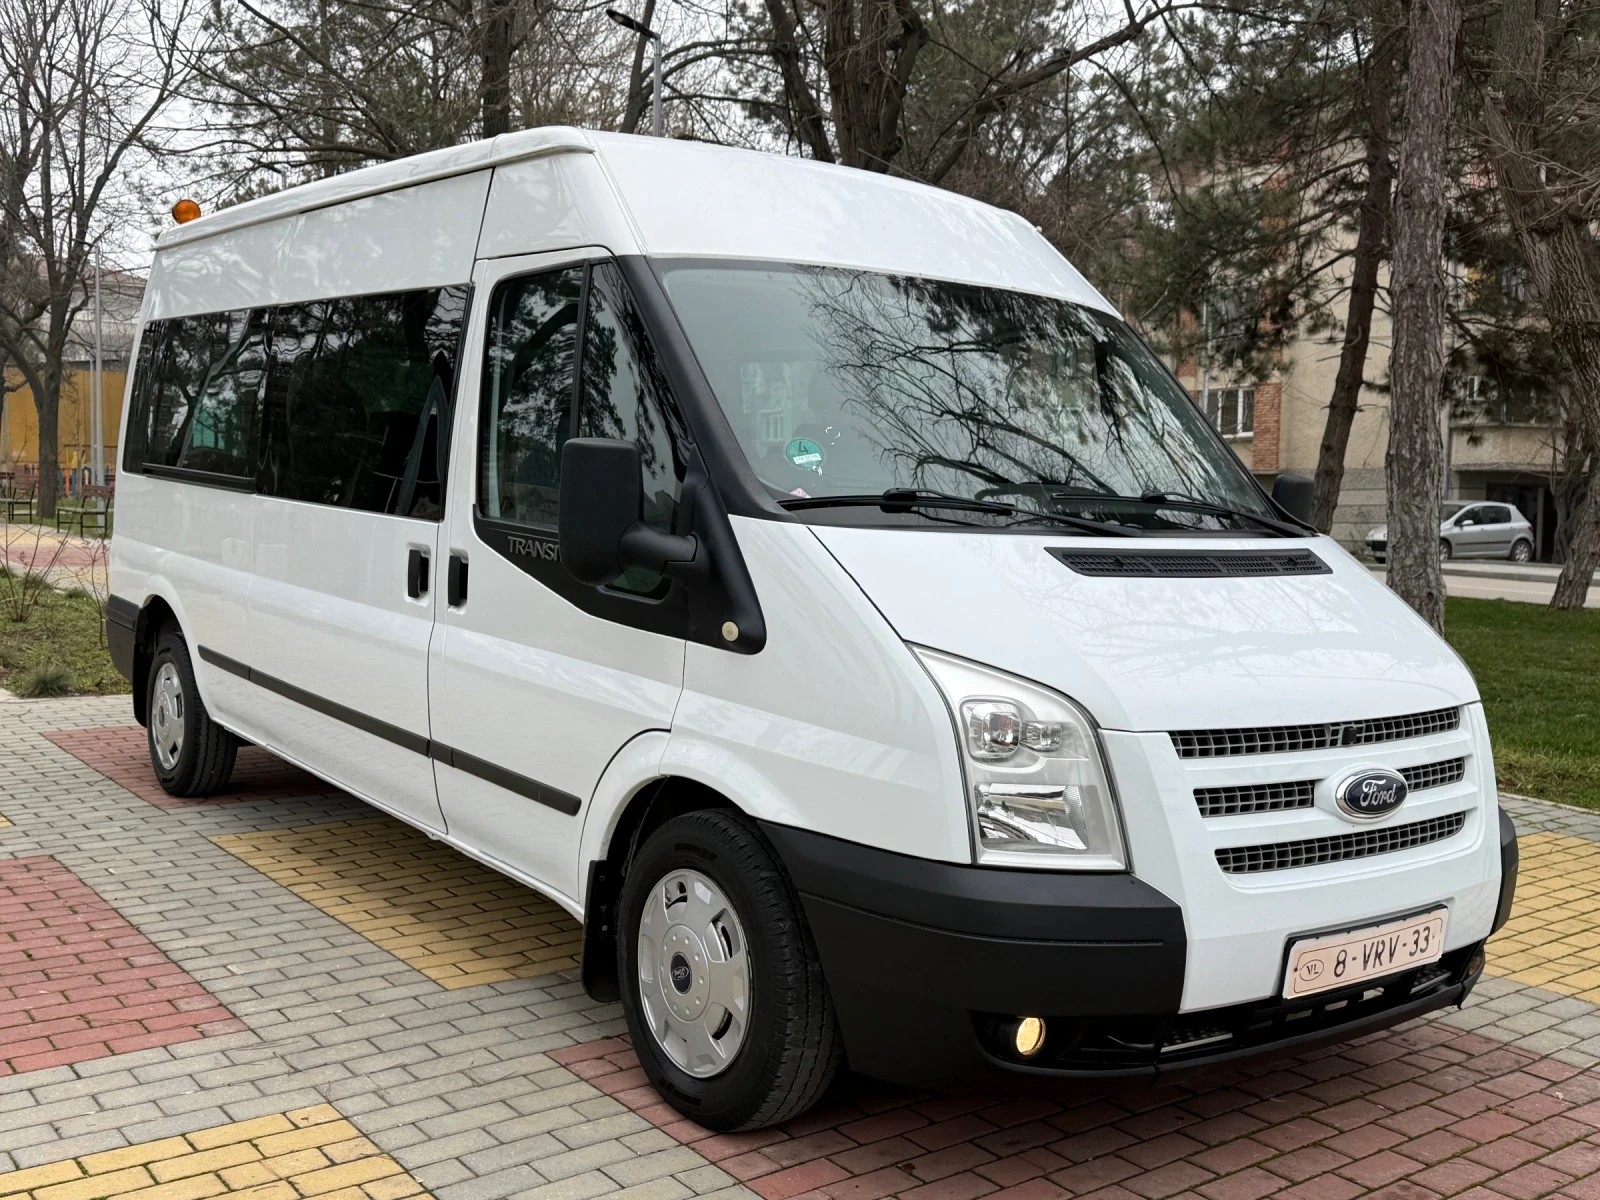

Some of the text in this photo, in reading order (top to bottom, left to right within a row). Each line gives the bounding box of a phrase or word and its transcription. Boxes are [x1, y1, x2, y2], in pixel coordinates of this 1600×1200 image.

[798, 441, 809, 454] 4
[1359, 778, 1397, 807] Ford
[1333, 925, 1431, 978] 8-VRV-33
[1305, 962, 1320, 976] VL
